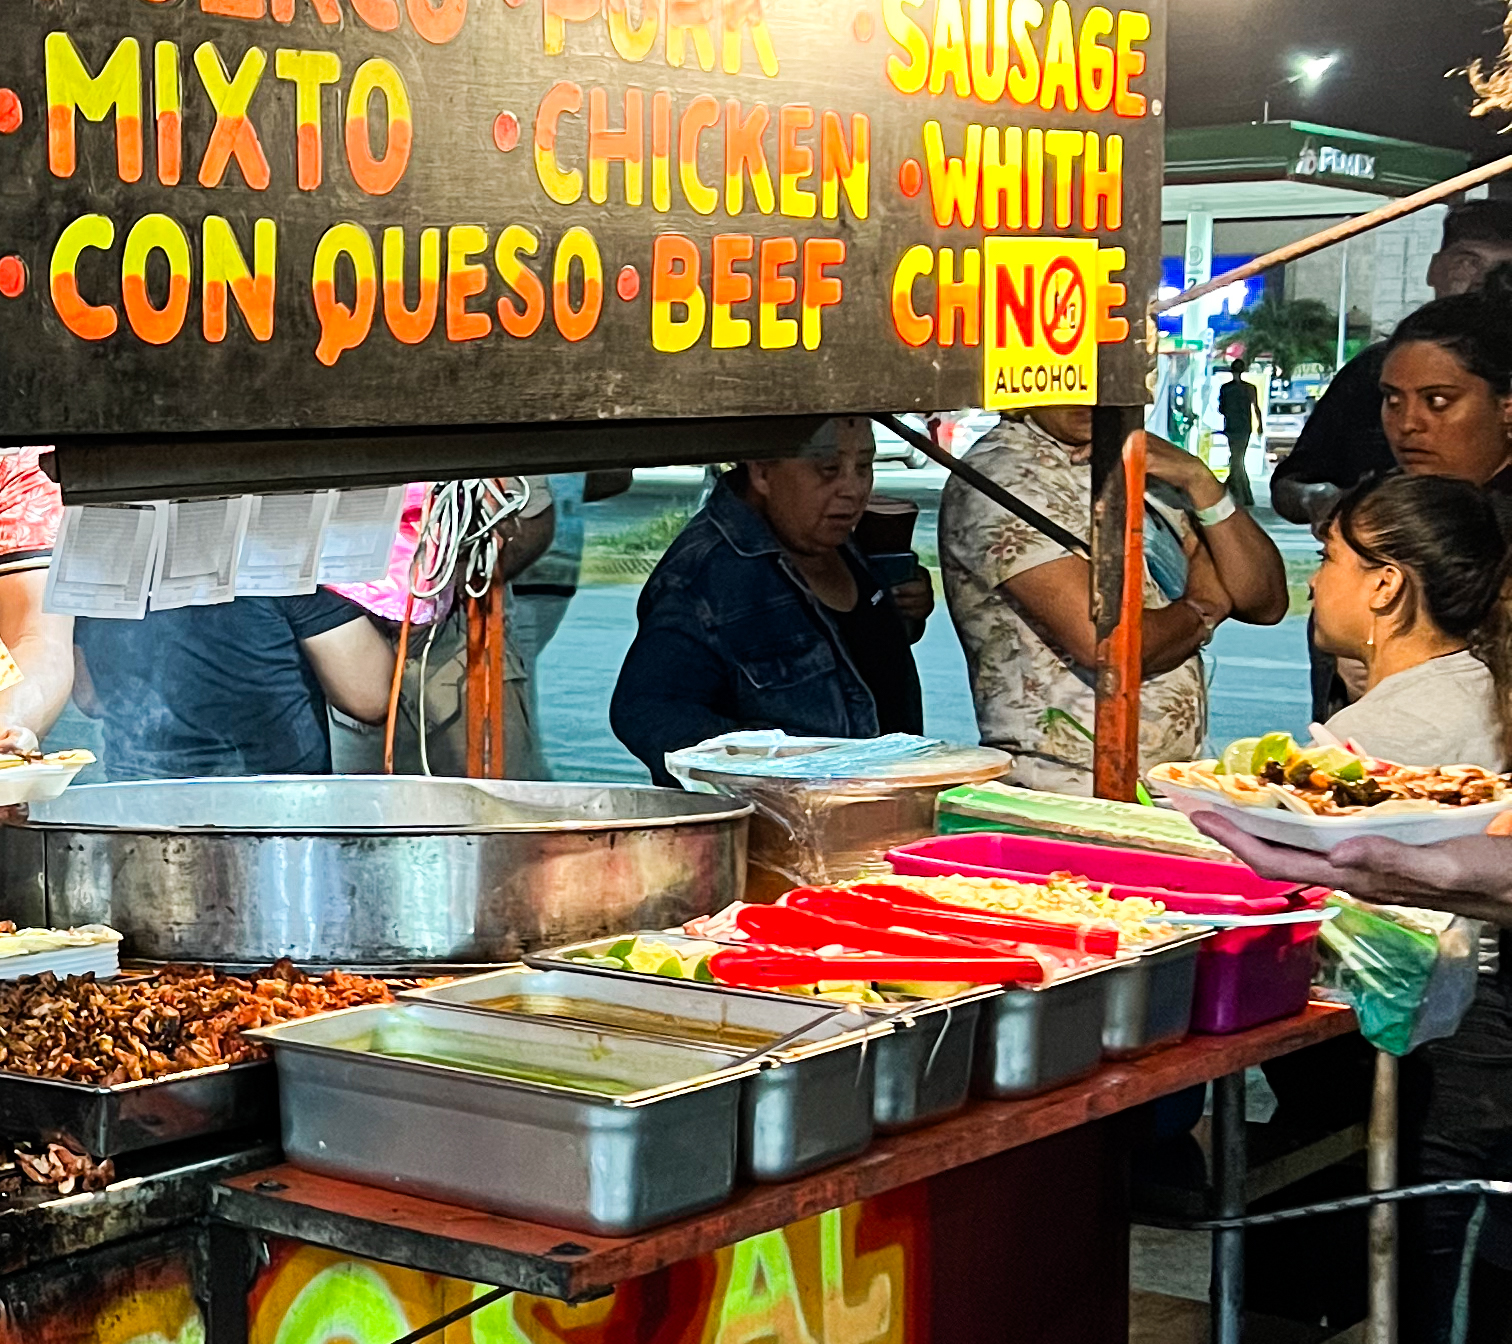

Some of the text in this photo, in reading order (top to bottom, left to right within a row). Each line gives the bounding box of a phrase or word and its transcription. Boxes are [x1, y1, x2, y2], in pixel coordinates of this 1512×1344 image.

[45, 31, 412, 195] MIXTO
[534, 80, 870, 220] CHICKEN
[924, 120, 1124, 230] WHITH
[49, 213, 276, 344] CON
[312, 221, 603, 366] QUESO
[652, 232, 846, 353] BEEF
[892, 244, 1130, 347] CHE
[994, 364, 1088, 394] ALCOHOL
